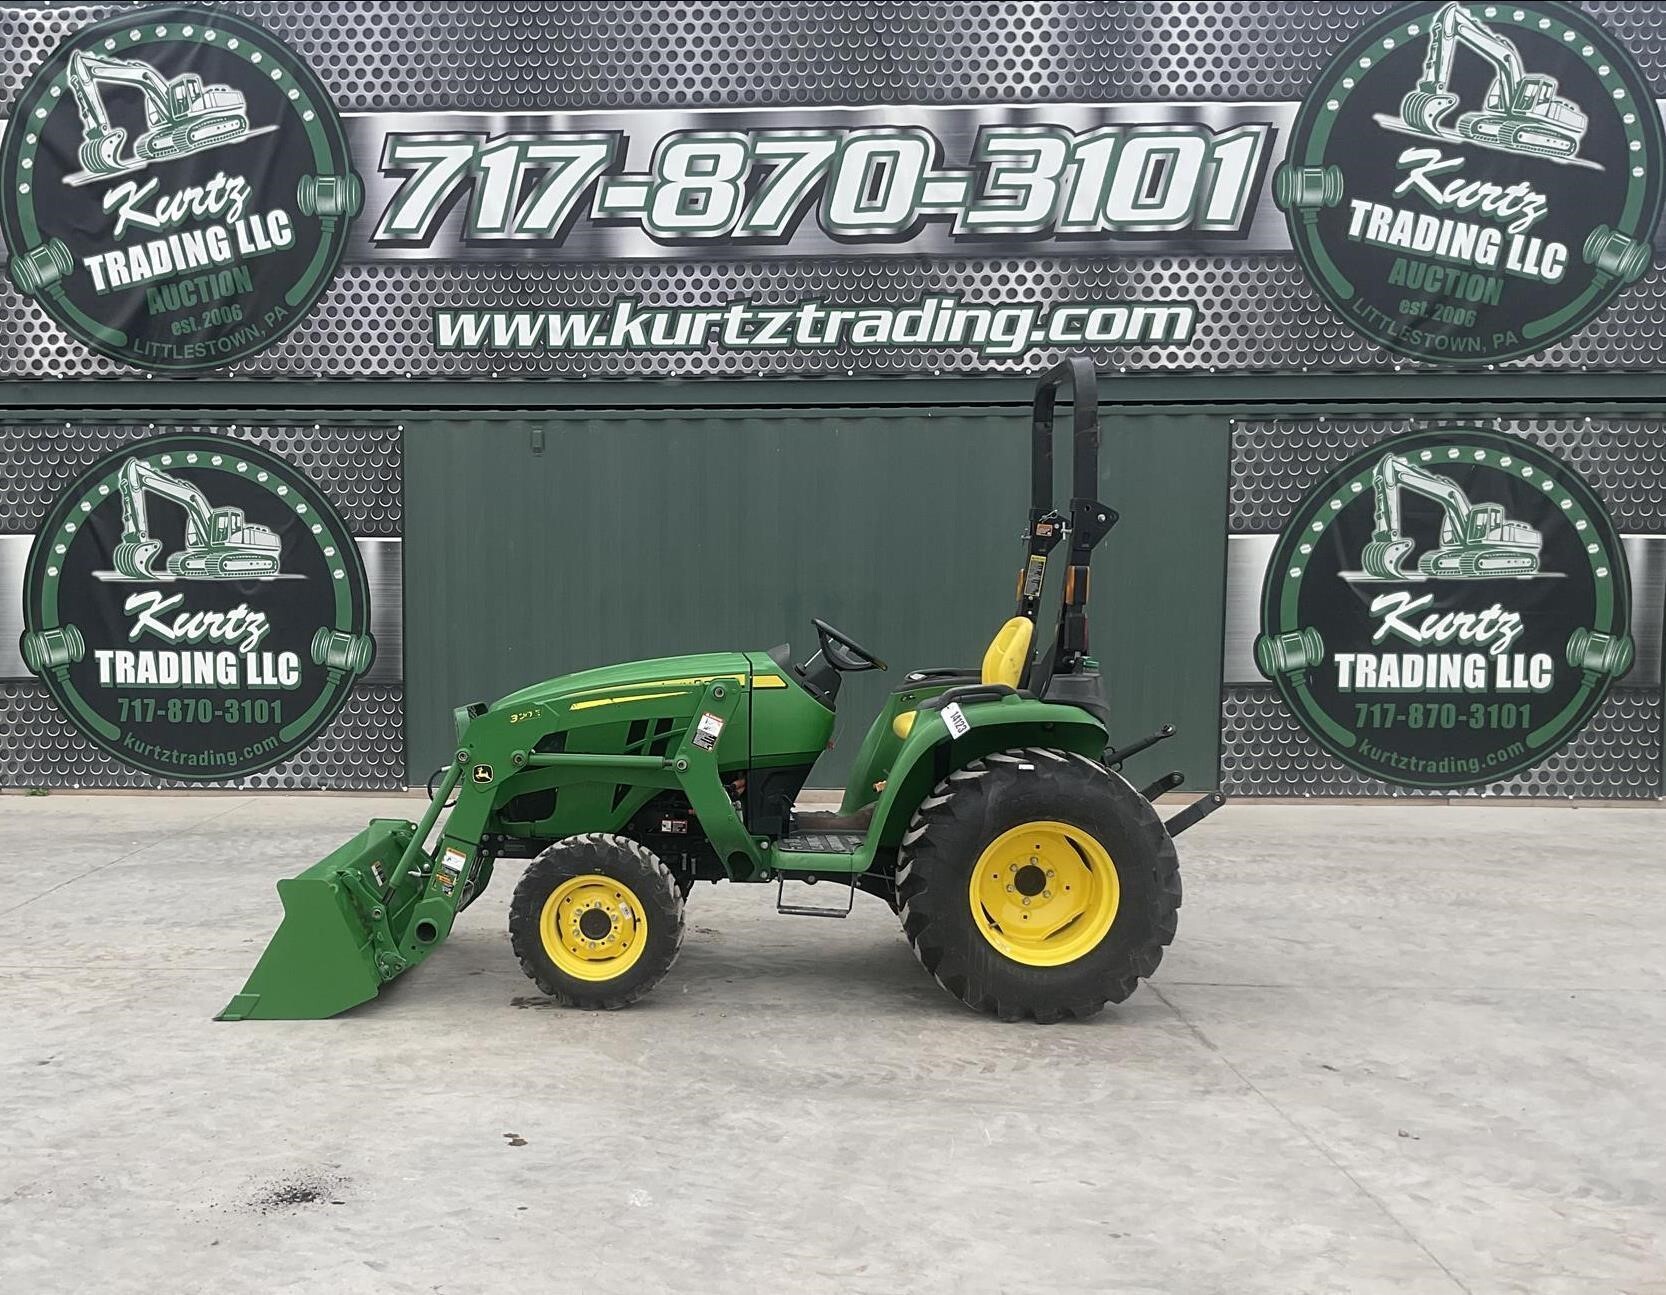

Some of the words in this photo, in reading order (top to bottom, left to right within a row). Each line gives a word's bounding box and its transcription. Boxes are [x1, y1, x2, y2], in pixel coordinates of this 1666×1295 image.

[103, 171, 251, 239] Kurtz
[374, 126, 1272, 244] 717-870-3101
[1393, 147, 1547, 235] Kurtz
[84, 225, 231, 293] TRADING
[235, 209, 294, 257] LLC
[1348, 199, 1502, 267] TRADING
[1505, 234, 1569, 281] LLC
[146, 266, 253, 315] AUCTION
[1388, 258, 1503, 306] AUCTION
[133, 323, 266, 360] LITTLESTOWN,
[264, 305, 289, 330] PA
[171, 316, 199, 336] est.
[202, 304, 243, 331] 2006
[436, 297, 1197, 356] www.kurtztrading.com
[1352, 297, 1486, 352] LITTLESTOWN,
[1493, 330, 1519, 350] PA
[1433, 304, 1476, 328] 2006
[125, 591, 270, 653] Kurtz
[1370, 591, 1524, 654] Kurtz
[95, 650, 238, 687] TRADING
[245, 651, 301, 687] LLC
[1334, 653, 1487, 690] TRADING
[1494, 653, 1554, 690] LLC
[118, 698, 283, 724] 717-870-3101
[950, 711, 968, 734] 14123
[1354, 703, 1532, 729] 717-870-3101
[124, 733, 280, 767] kurtztrading.com
[1357, 738, 1525, 774] kurtztrading.com
